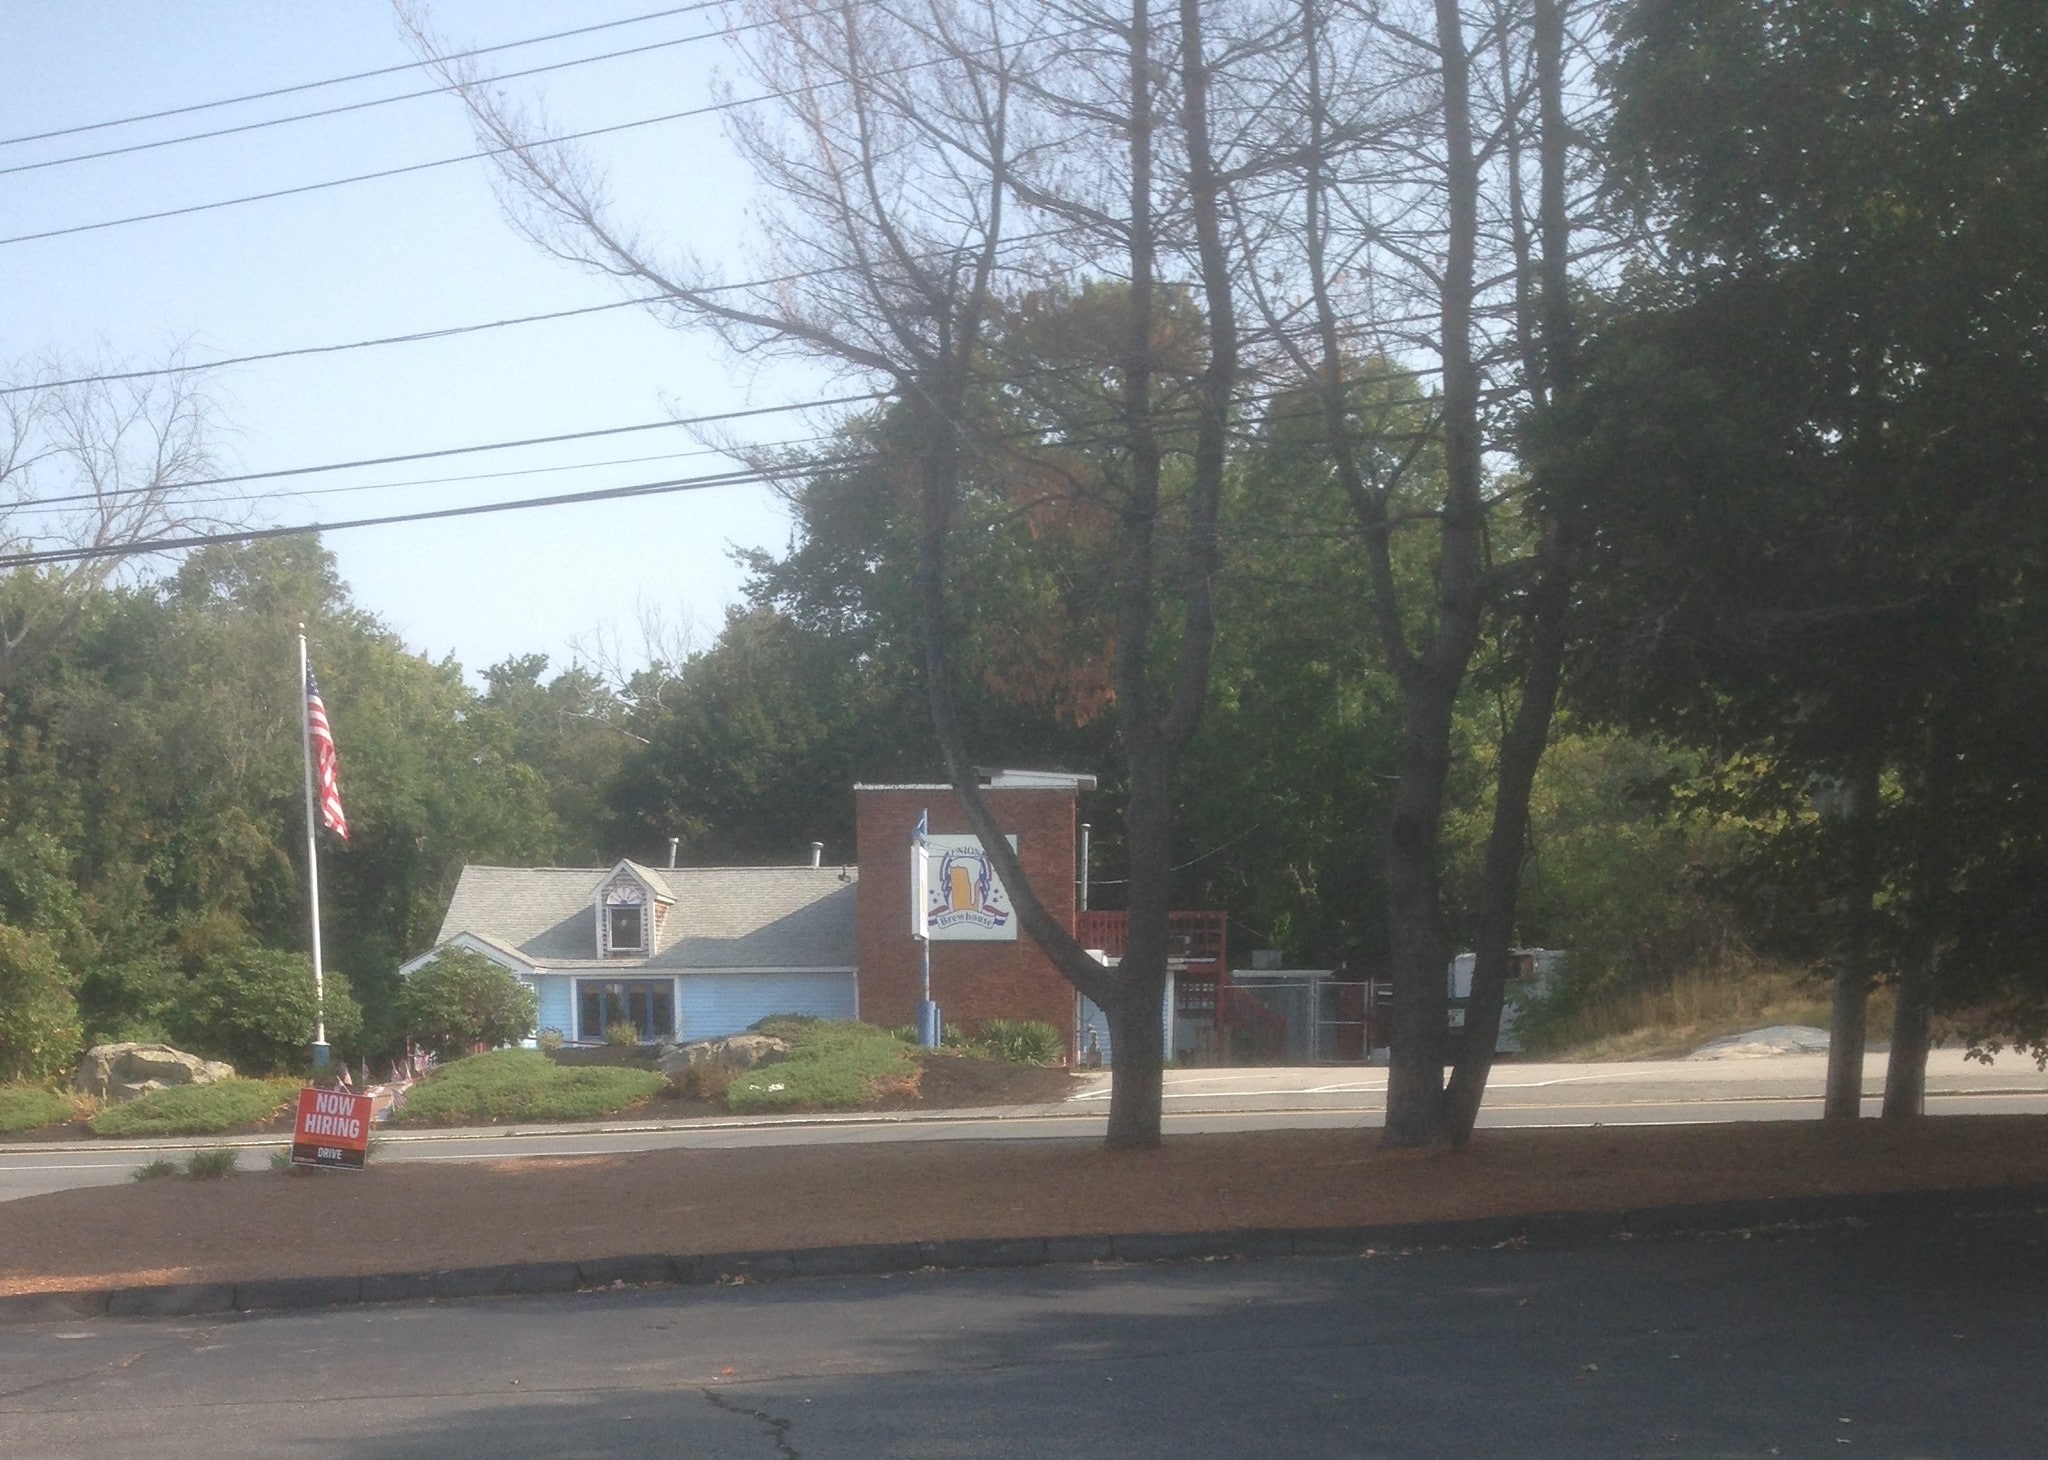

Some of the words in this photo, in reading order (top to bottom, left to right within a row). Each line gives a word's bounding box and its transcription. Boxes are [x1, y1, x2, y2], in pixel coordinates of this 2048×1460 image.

[940, 912, 992, 926] Brewhouse
[316, 1093, 355, 1116] NOW
[304, 1114, 360, 1138] HIRING
[318, 1147, 343, 1160] DRIVE
